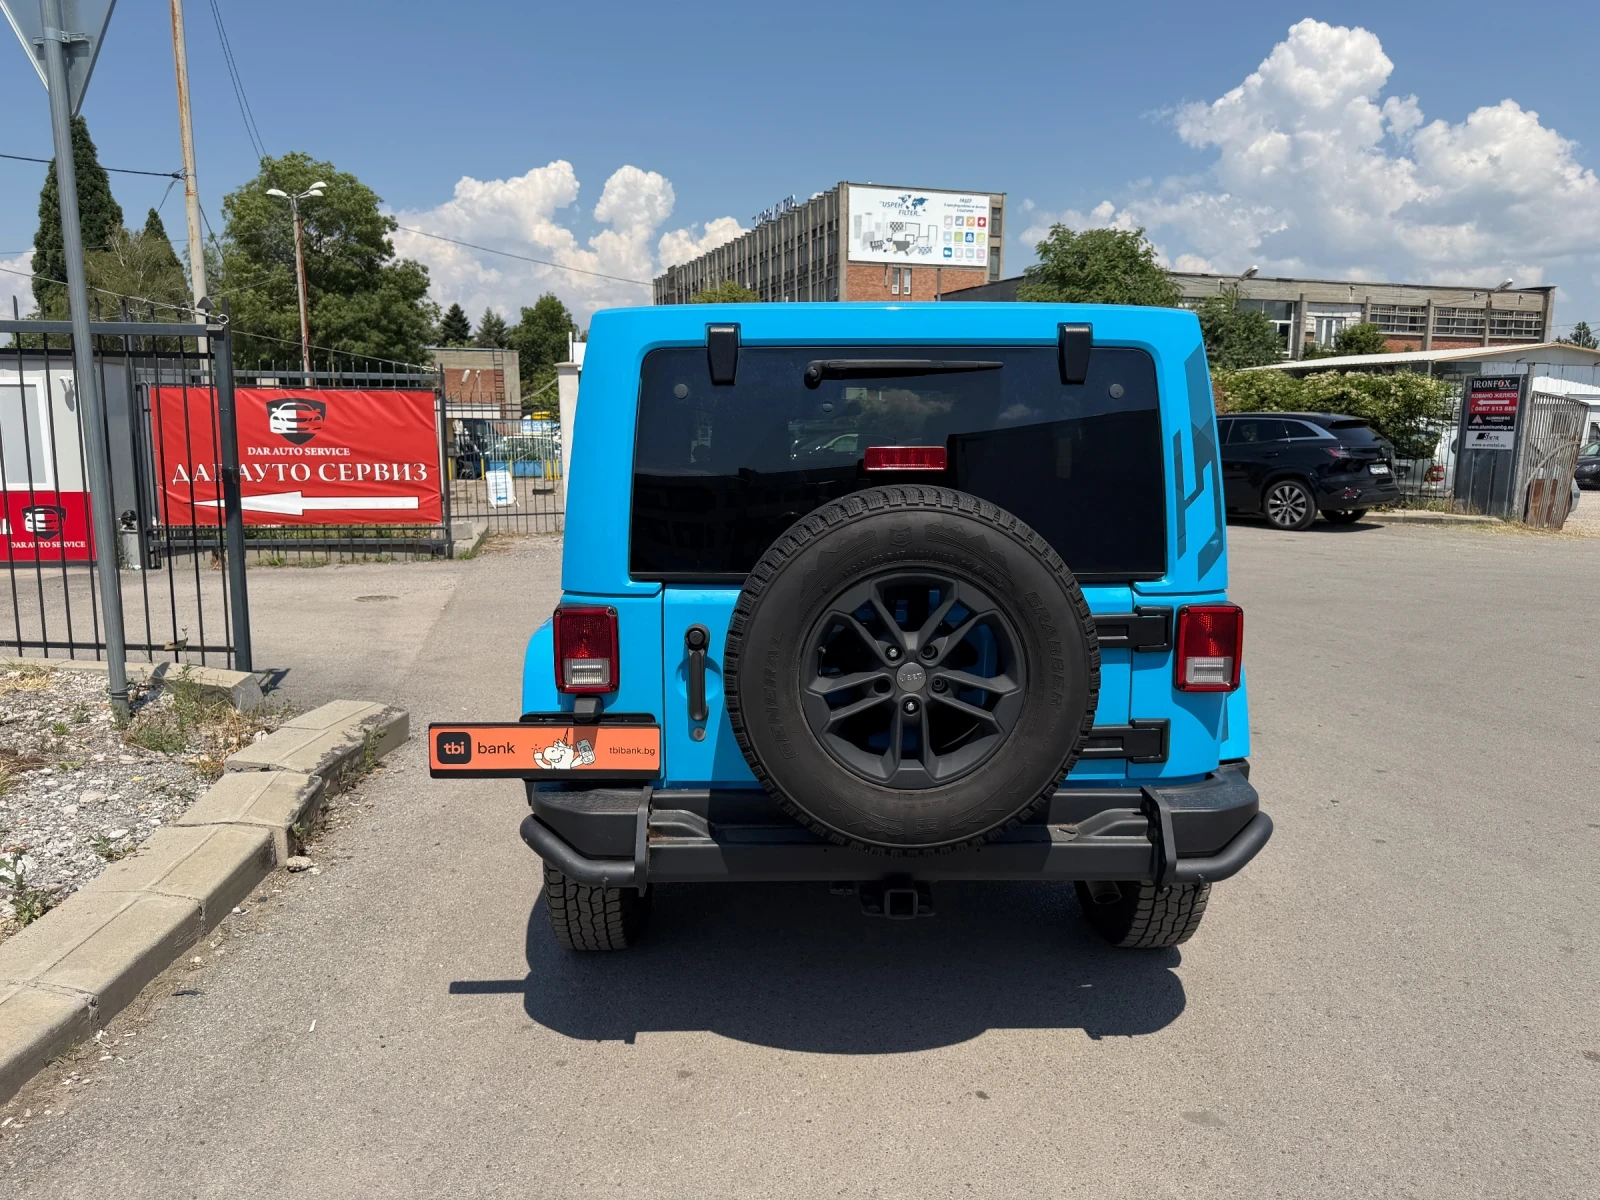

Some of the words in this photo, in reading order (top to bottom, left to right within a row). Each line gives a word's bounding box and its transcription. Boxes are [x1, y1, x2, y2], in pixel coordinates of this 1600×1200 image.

[1473, 380, 1511, 388] IRONFOX
[247, 447, 270, 456] DAR
[272, 447, 303, 456] AUTO
[304, 447, 350, 456] SERVICE
[238, 463, 311, 483] АУТО
[318, 462, 428, 482] СЕРВИЗ
[1025, 591, 1065, 709] GRABBER
[765, 632, 799, 759] GENERAL
[443, 741, 465, 755] tbi
[477, 741, 516, 755] bank
[609, 746, 656, 757] tbibank.bg
